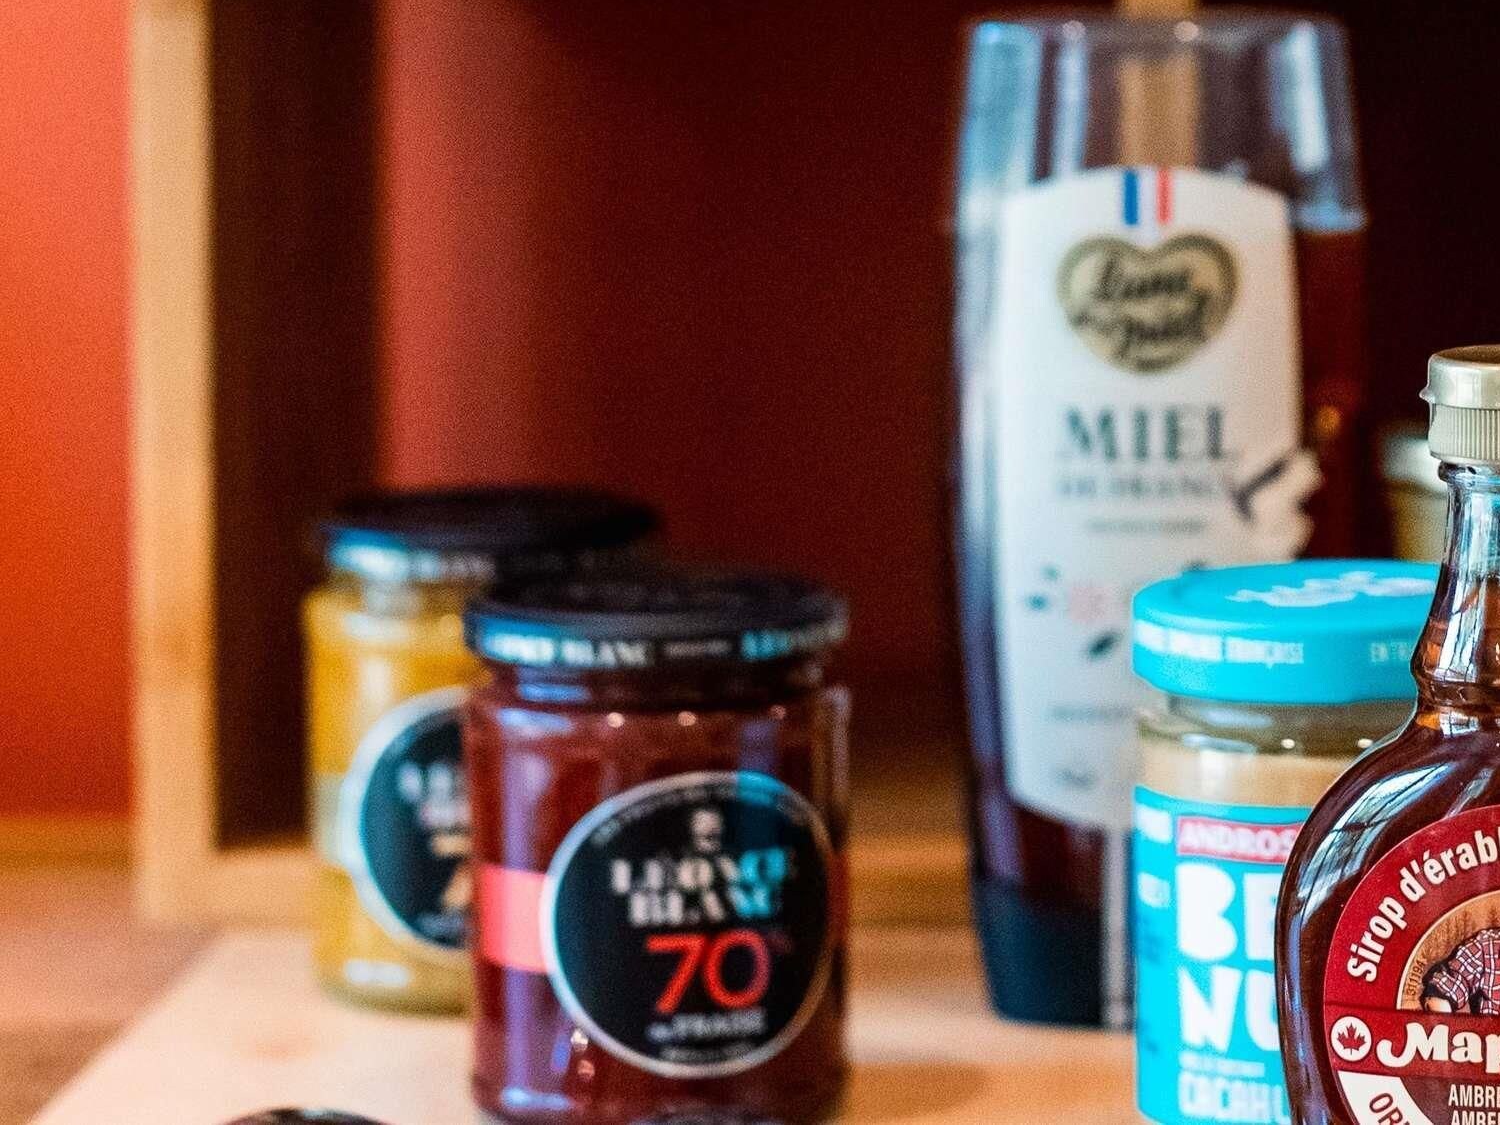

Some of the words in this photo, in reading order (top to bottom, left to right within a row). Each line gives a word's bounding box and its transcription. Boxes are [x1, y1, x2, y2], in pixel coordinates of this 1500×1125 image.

[1060, 406, 1240, 462] MIEL
[1346, 895, 1408, 983] Sirop
[1369, 1092, 1411, 1125] OR
